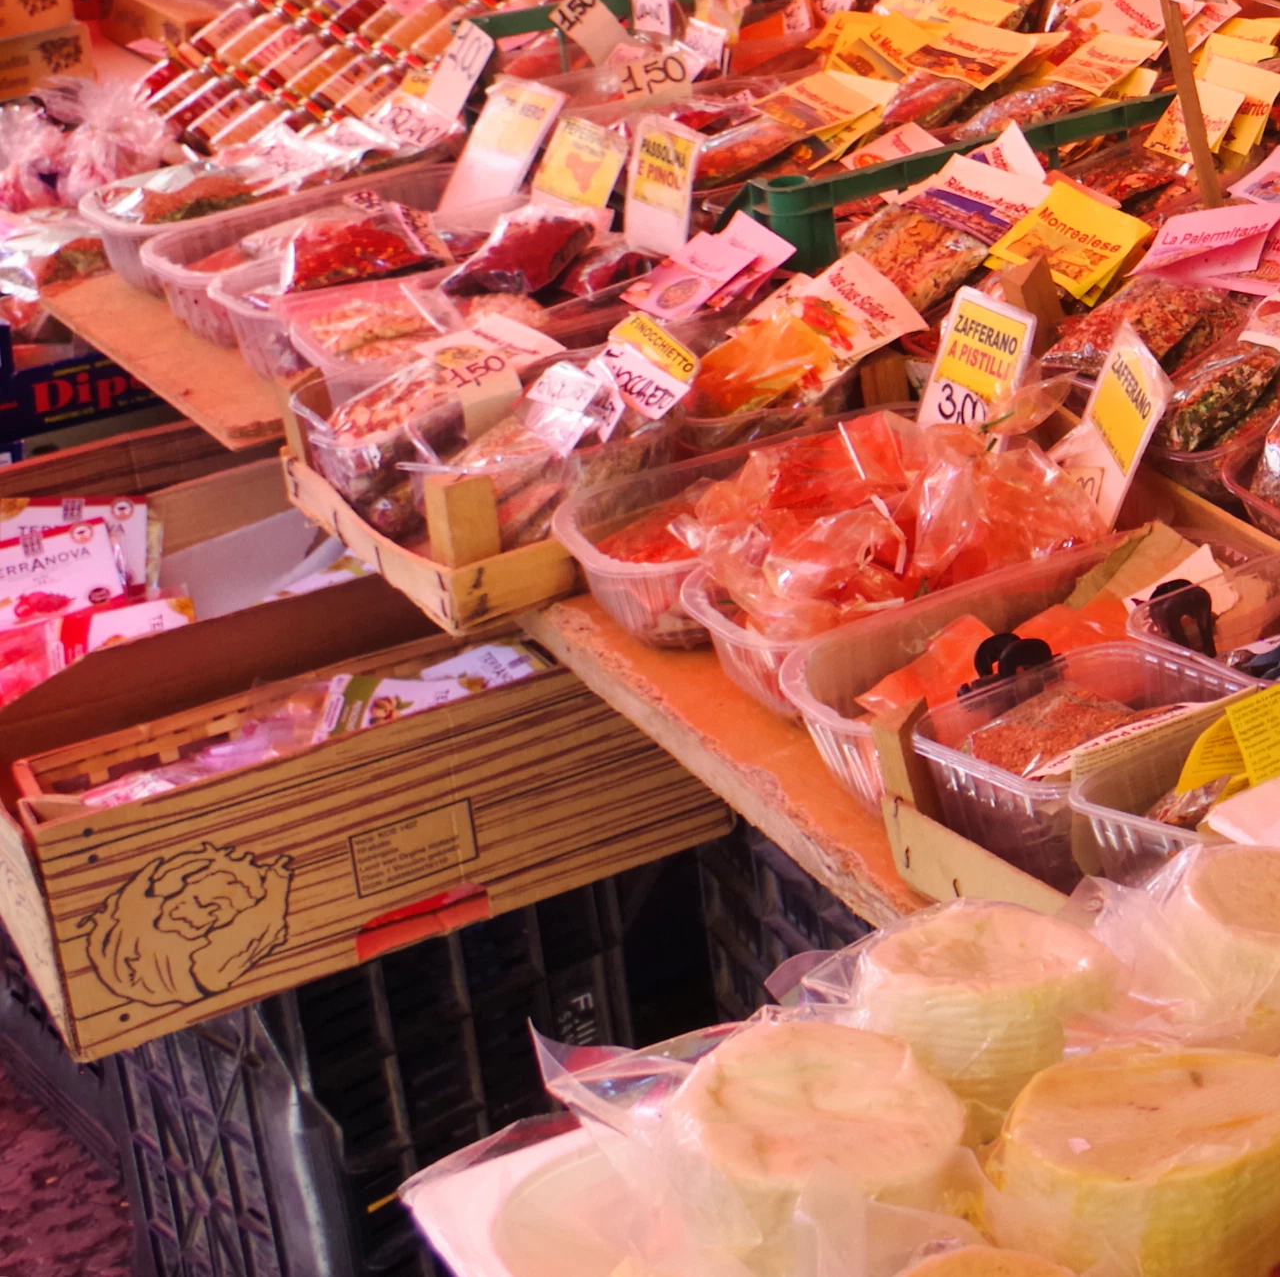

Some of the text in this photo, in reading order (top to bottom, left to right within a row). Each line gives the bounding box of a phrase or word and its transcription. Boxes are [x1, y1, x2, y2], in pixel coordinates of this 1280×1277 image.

[621, 55, 686, 94] 1,50
[1038, 207, 1123, 253] Monrealese
[1162, 223, 1269, 246] La Palermitana
[630, 317, 694, 373] FINOCCHIETTO
[953, 314, 1018, 356] ZAFFERANO
[449, 355, 505, 388] 1,50
[947, 340, 1010, 380] A PISTILLI
[1111, 352, 1152, 421] ZAFFERANO
